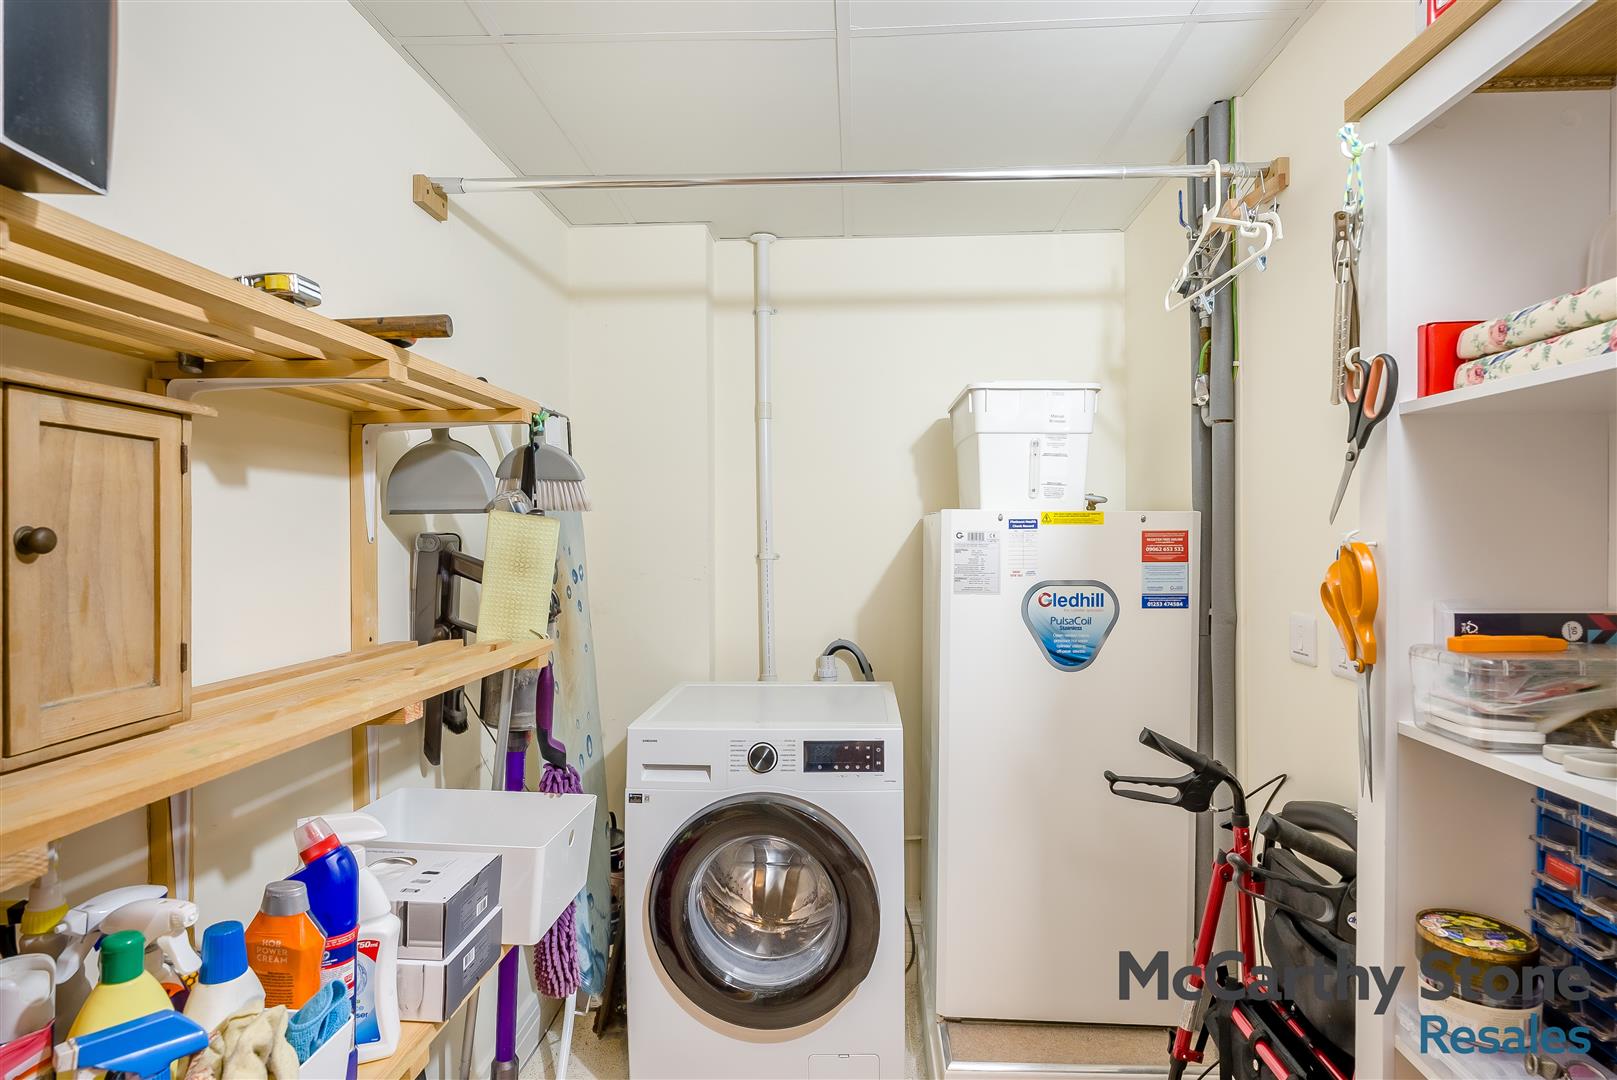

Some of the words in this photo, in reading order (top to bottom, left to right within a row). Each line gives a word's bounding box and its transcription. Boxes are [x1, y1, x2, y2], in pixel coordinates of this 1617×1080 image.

[1038, 592, 1104, 608] Gledhill
[1050, 616, 1092, 626] PulsaCoil
[262, 938, 282, 947] HOB
[256, 945, 289, 956] POWER
[256, 953, 288, 964] CREAM
